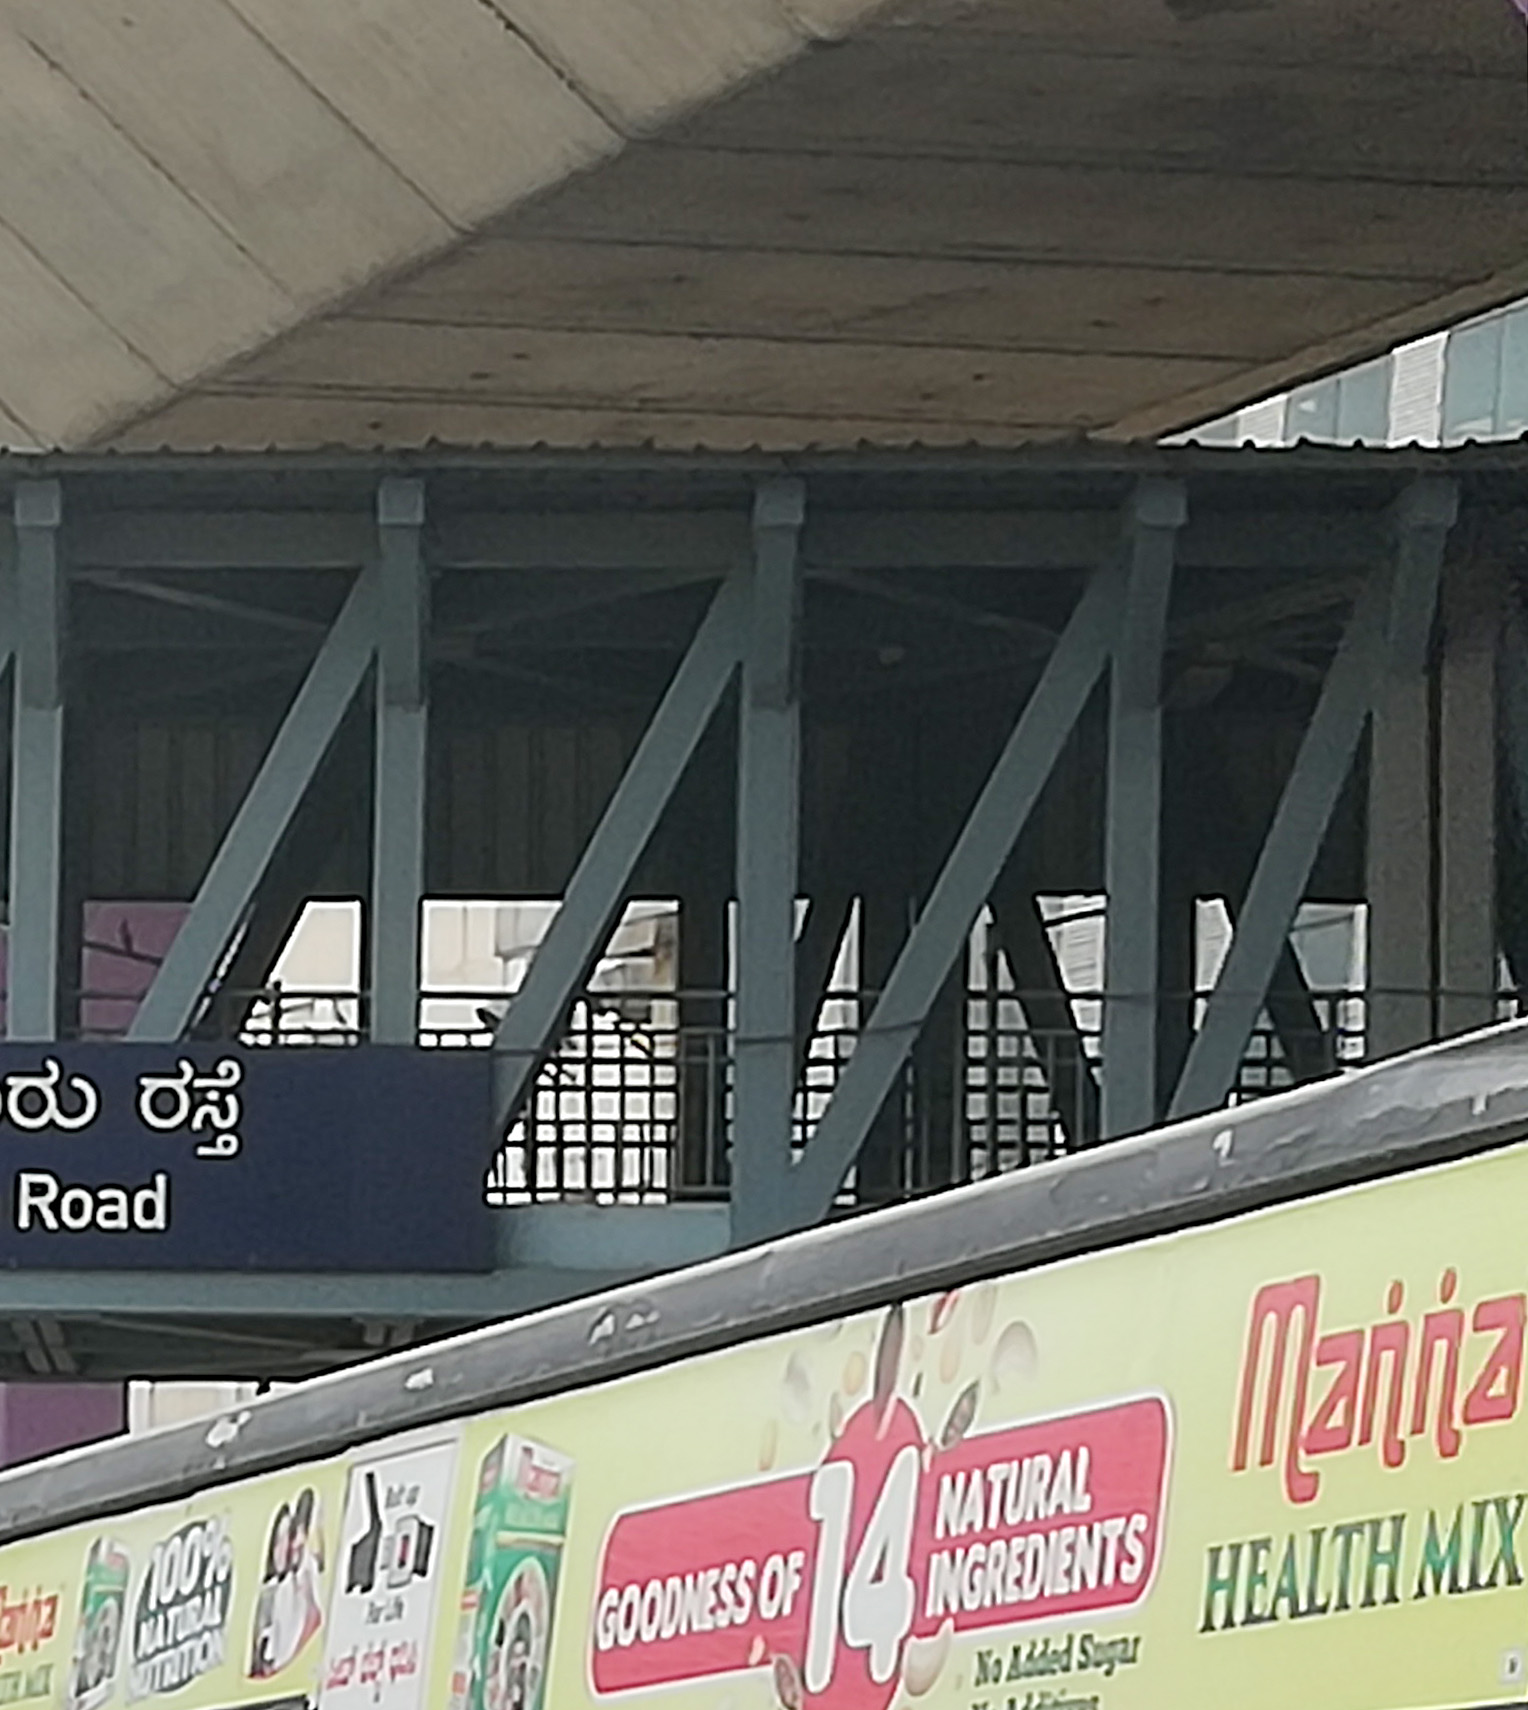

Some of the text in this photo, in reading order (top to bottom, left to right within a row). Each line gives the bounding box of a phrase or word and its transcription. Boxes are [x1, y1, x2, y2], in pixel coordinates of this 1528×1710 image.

[139, 1057, 245, 1157] ರಸ್ತೆ
[18, 1173, 170, 1233] Road
[1228, 1268, 1528, 1505] Manna
[934, 1446, 1094, 1541] NATURAL
[148, 1514, 232, 1611] 100%
[595, 1545, 806, 1651] GOODNESS OF
[806, 1445, 919, 1694] 14
[925, 1514, 1148, 1621] INGREDIENTS
[1197, 1492, 1526, 1635] HEALTH MIX
[138, 1587, 222, 1660] NATURAL
[975, 1634, 1141, 1686] No Added Sugar
